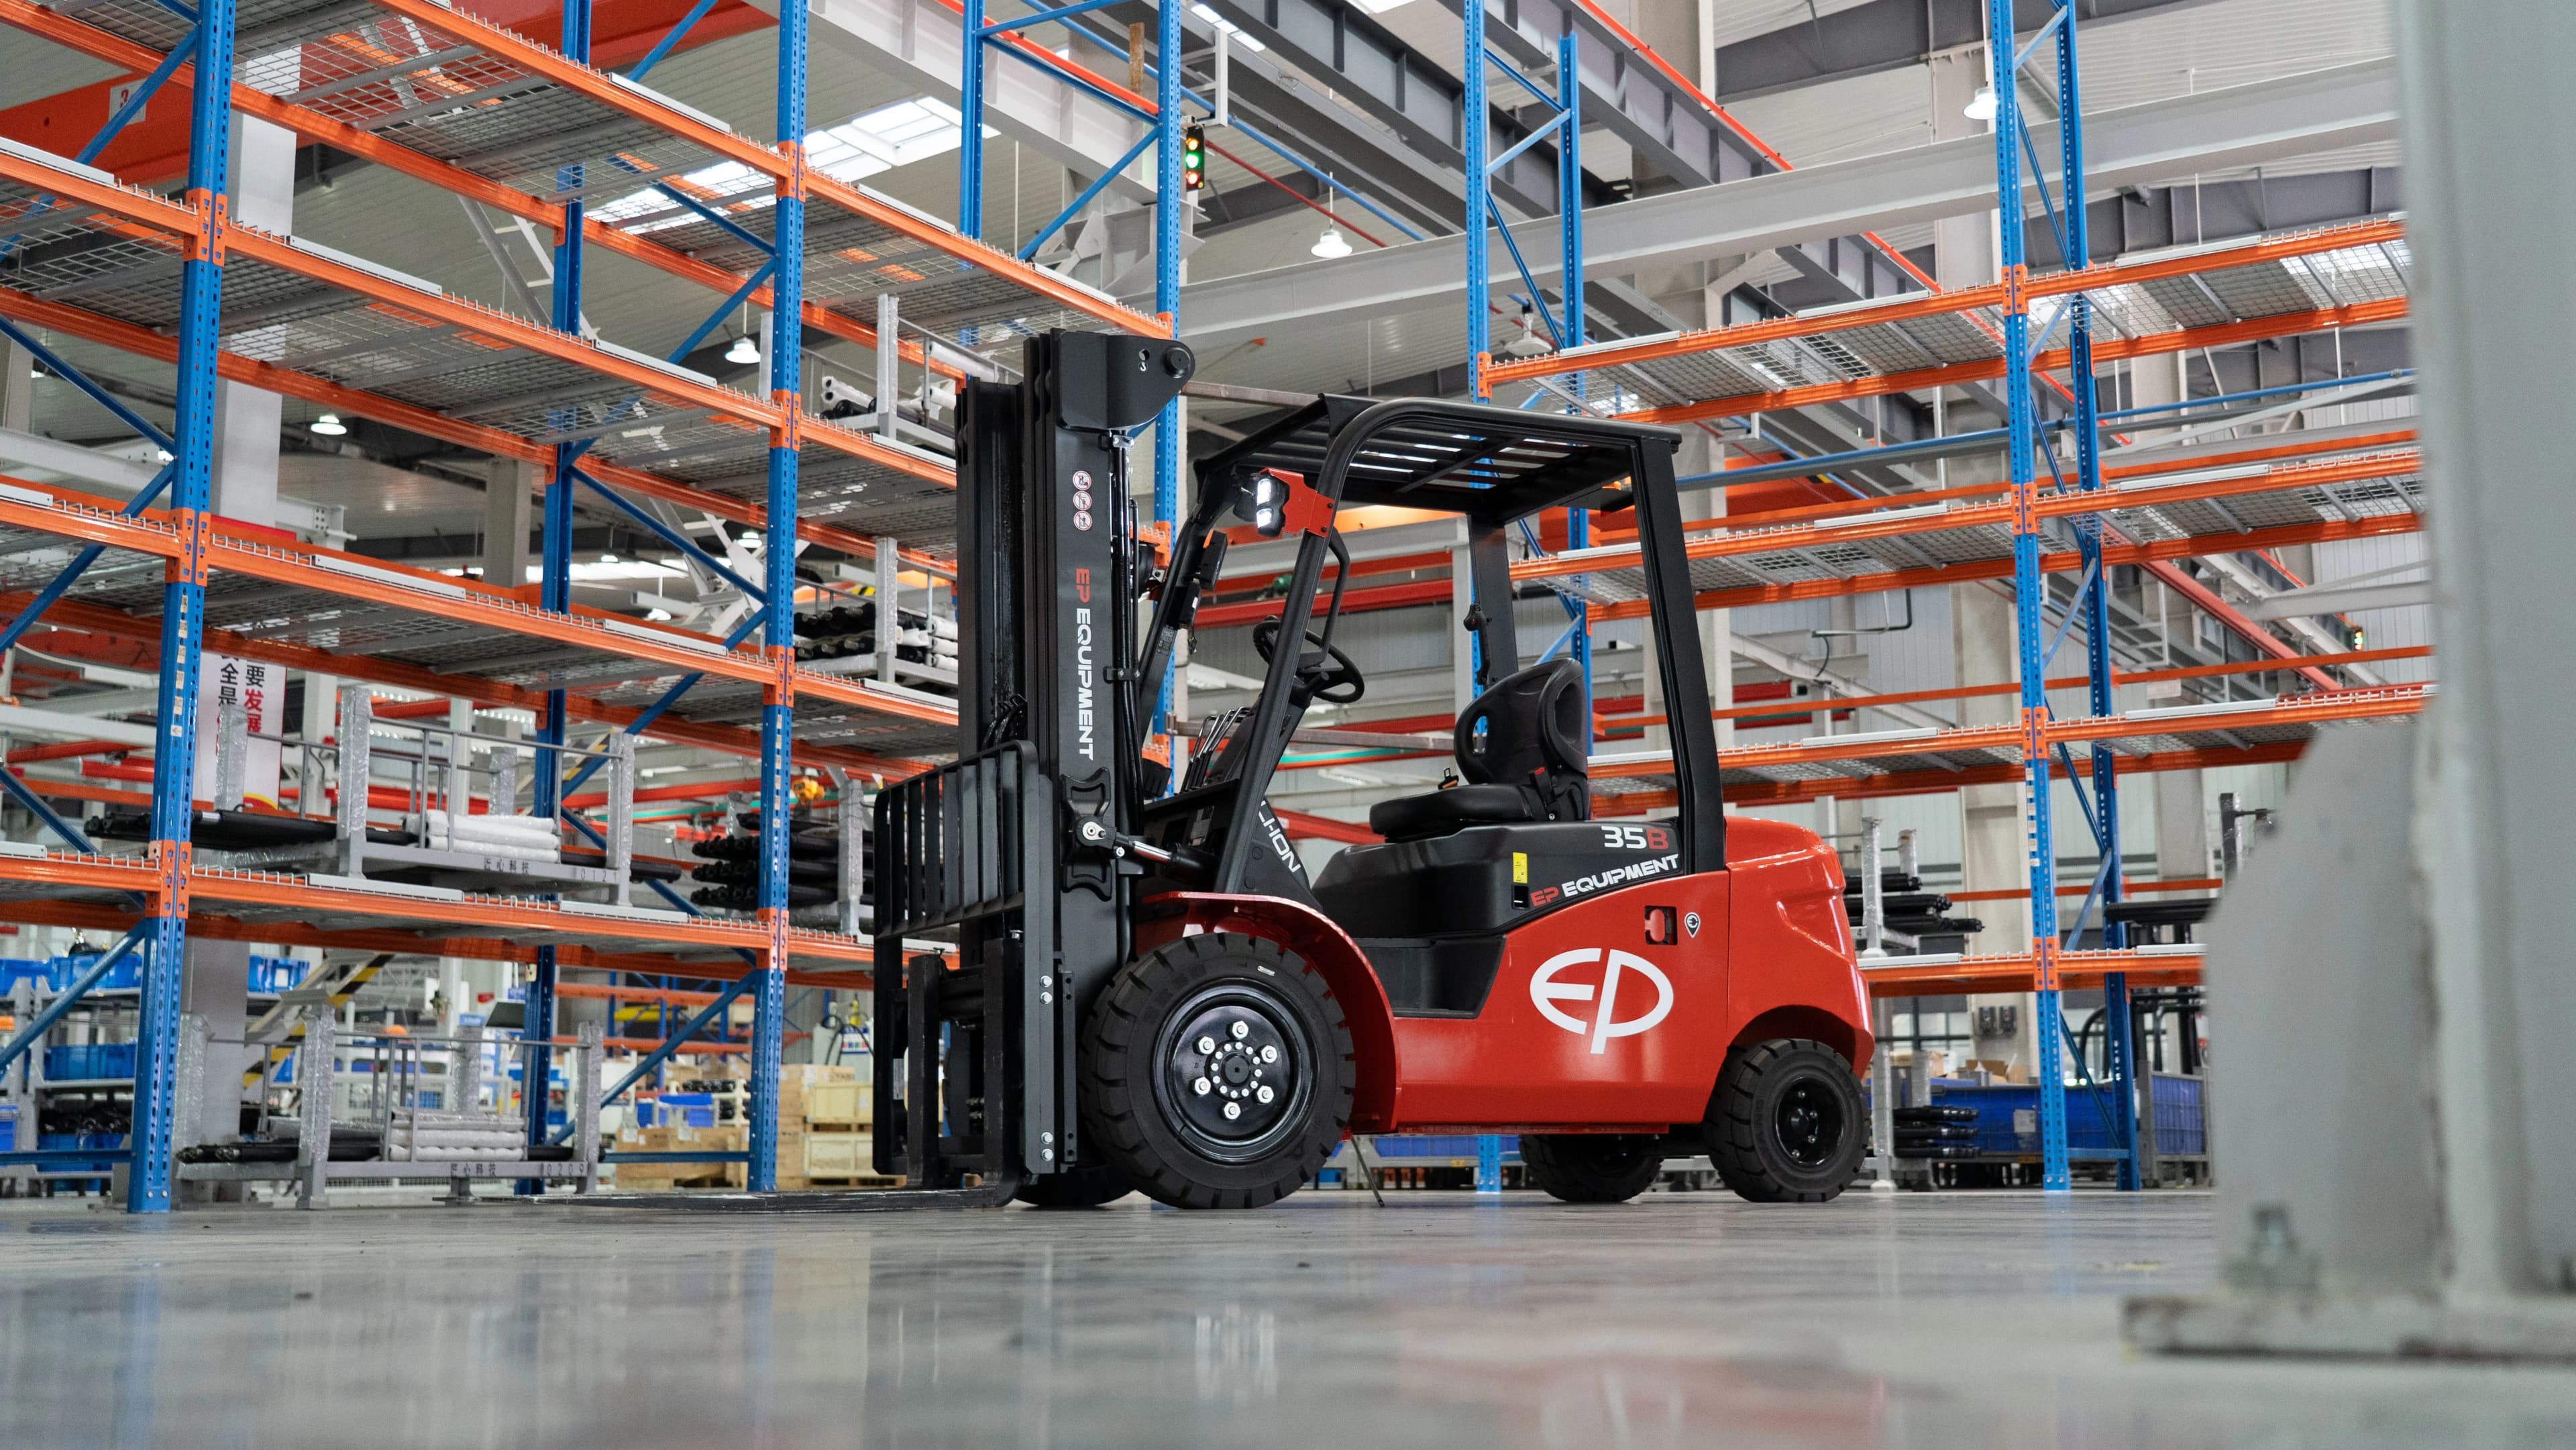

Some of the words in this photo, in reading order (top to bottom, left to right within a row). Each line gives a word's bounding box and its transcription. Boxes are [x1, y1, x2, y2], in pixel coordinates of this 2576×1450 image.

[1075, 568, 1090, 603] EP
[218, 656, 239, 707] 全是
[244, 664, 266, 734] 要发展
[1076, 607, 1094, 762] EQUIPMENT
[1601, 825, 1669, 850] 35B
[1529, 886, 1559, 907] EP
[1561, 853, 1679, 898] EQUIPMENT
[1529, 947, 1674, 1055] EP
